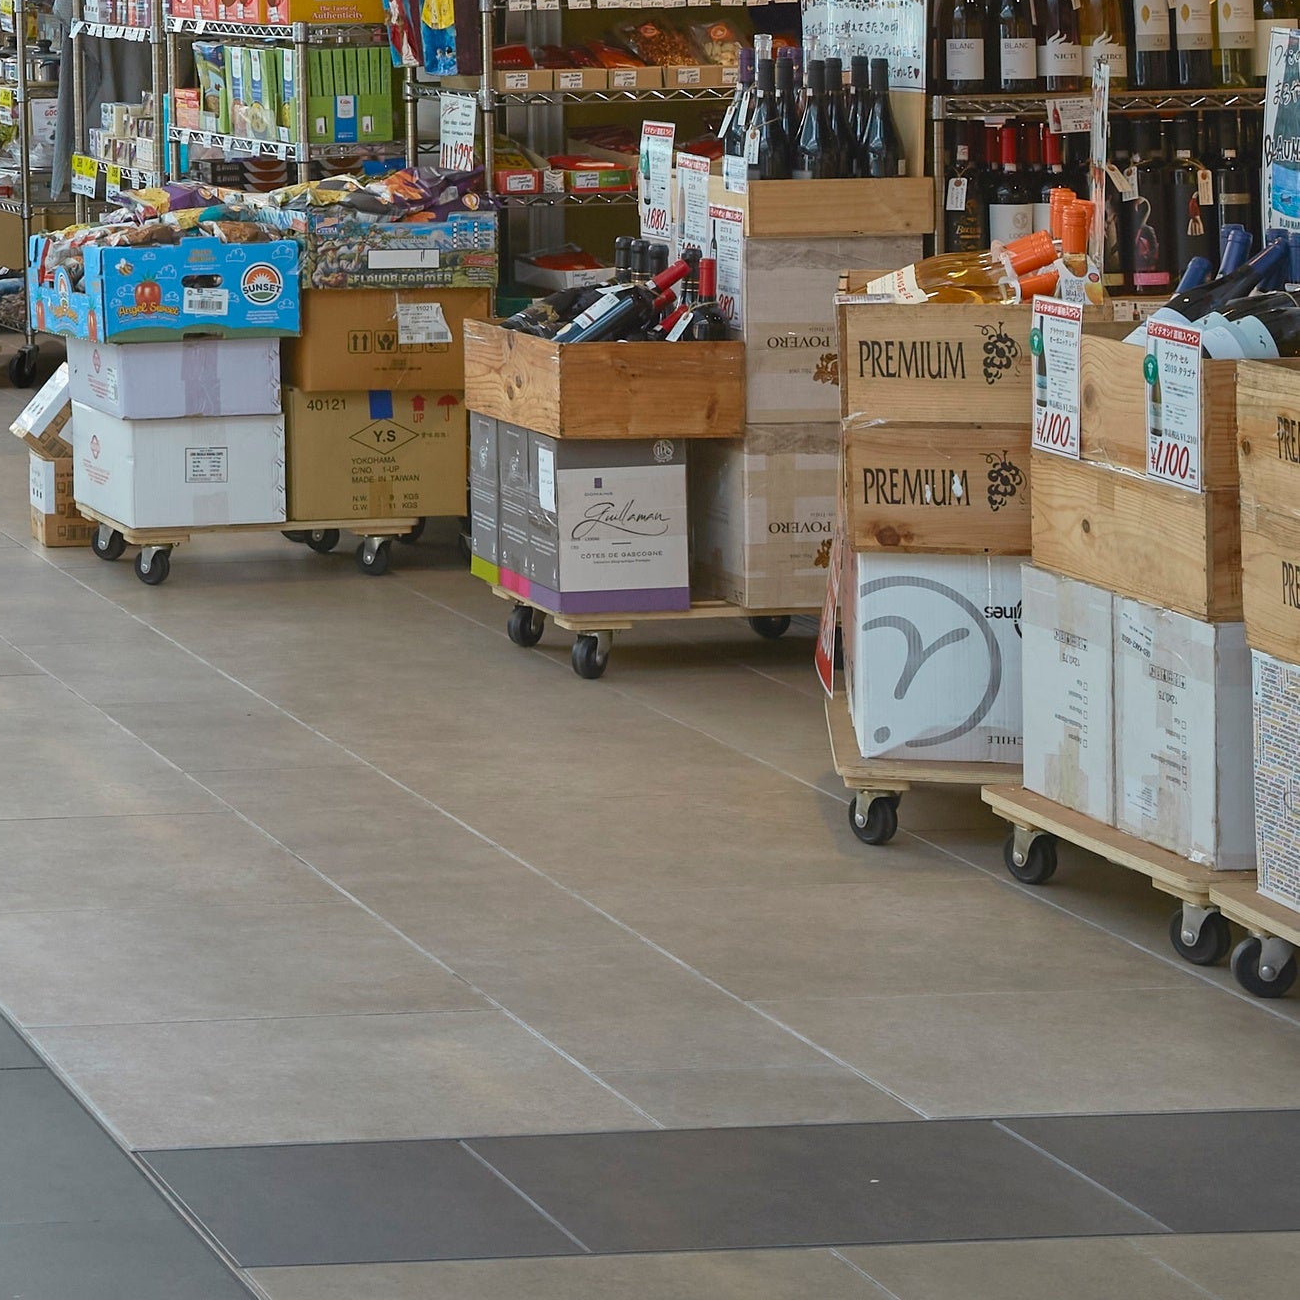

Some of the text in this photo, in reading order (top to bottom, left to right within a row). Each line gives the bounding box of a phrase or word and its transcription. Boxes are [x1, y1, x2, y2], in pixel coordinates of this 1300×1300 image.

[312, 11, 364, 20] Authenticity
[949, 42, 975, 50] BLANC
[242, 283, 283, 296] SUNSET
[118, 302, 180, 317] Angel Sweet
[766, 336, 831, 350] POVERO
[858, 340, 967, 379] PREMIUM
[306, 399, 346, 411] 40121
[412, 413, 425, 423] UP
[373, 429, 396, 442] Y.S
[1035, 411, 1071, 448] ¥1,100
[351, 456, 396, 465] YOKOHAMA
[1150, 440, 1190, 480] ¥1,100
[382, 465, 400, 473] 1-UP
[351, 474, 420, 484] MADE IN TAIWAN
[862, 467, 971, 507] PREMIUM
[401, 501, 418, 509] KGS
[572, 499, 671, 540] Guillaman
[768, 521, 832, 535] POVERO
[621, 550, 663, 558] GASCOGNE
